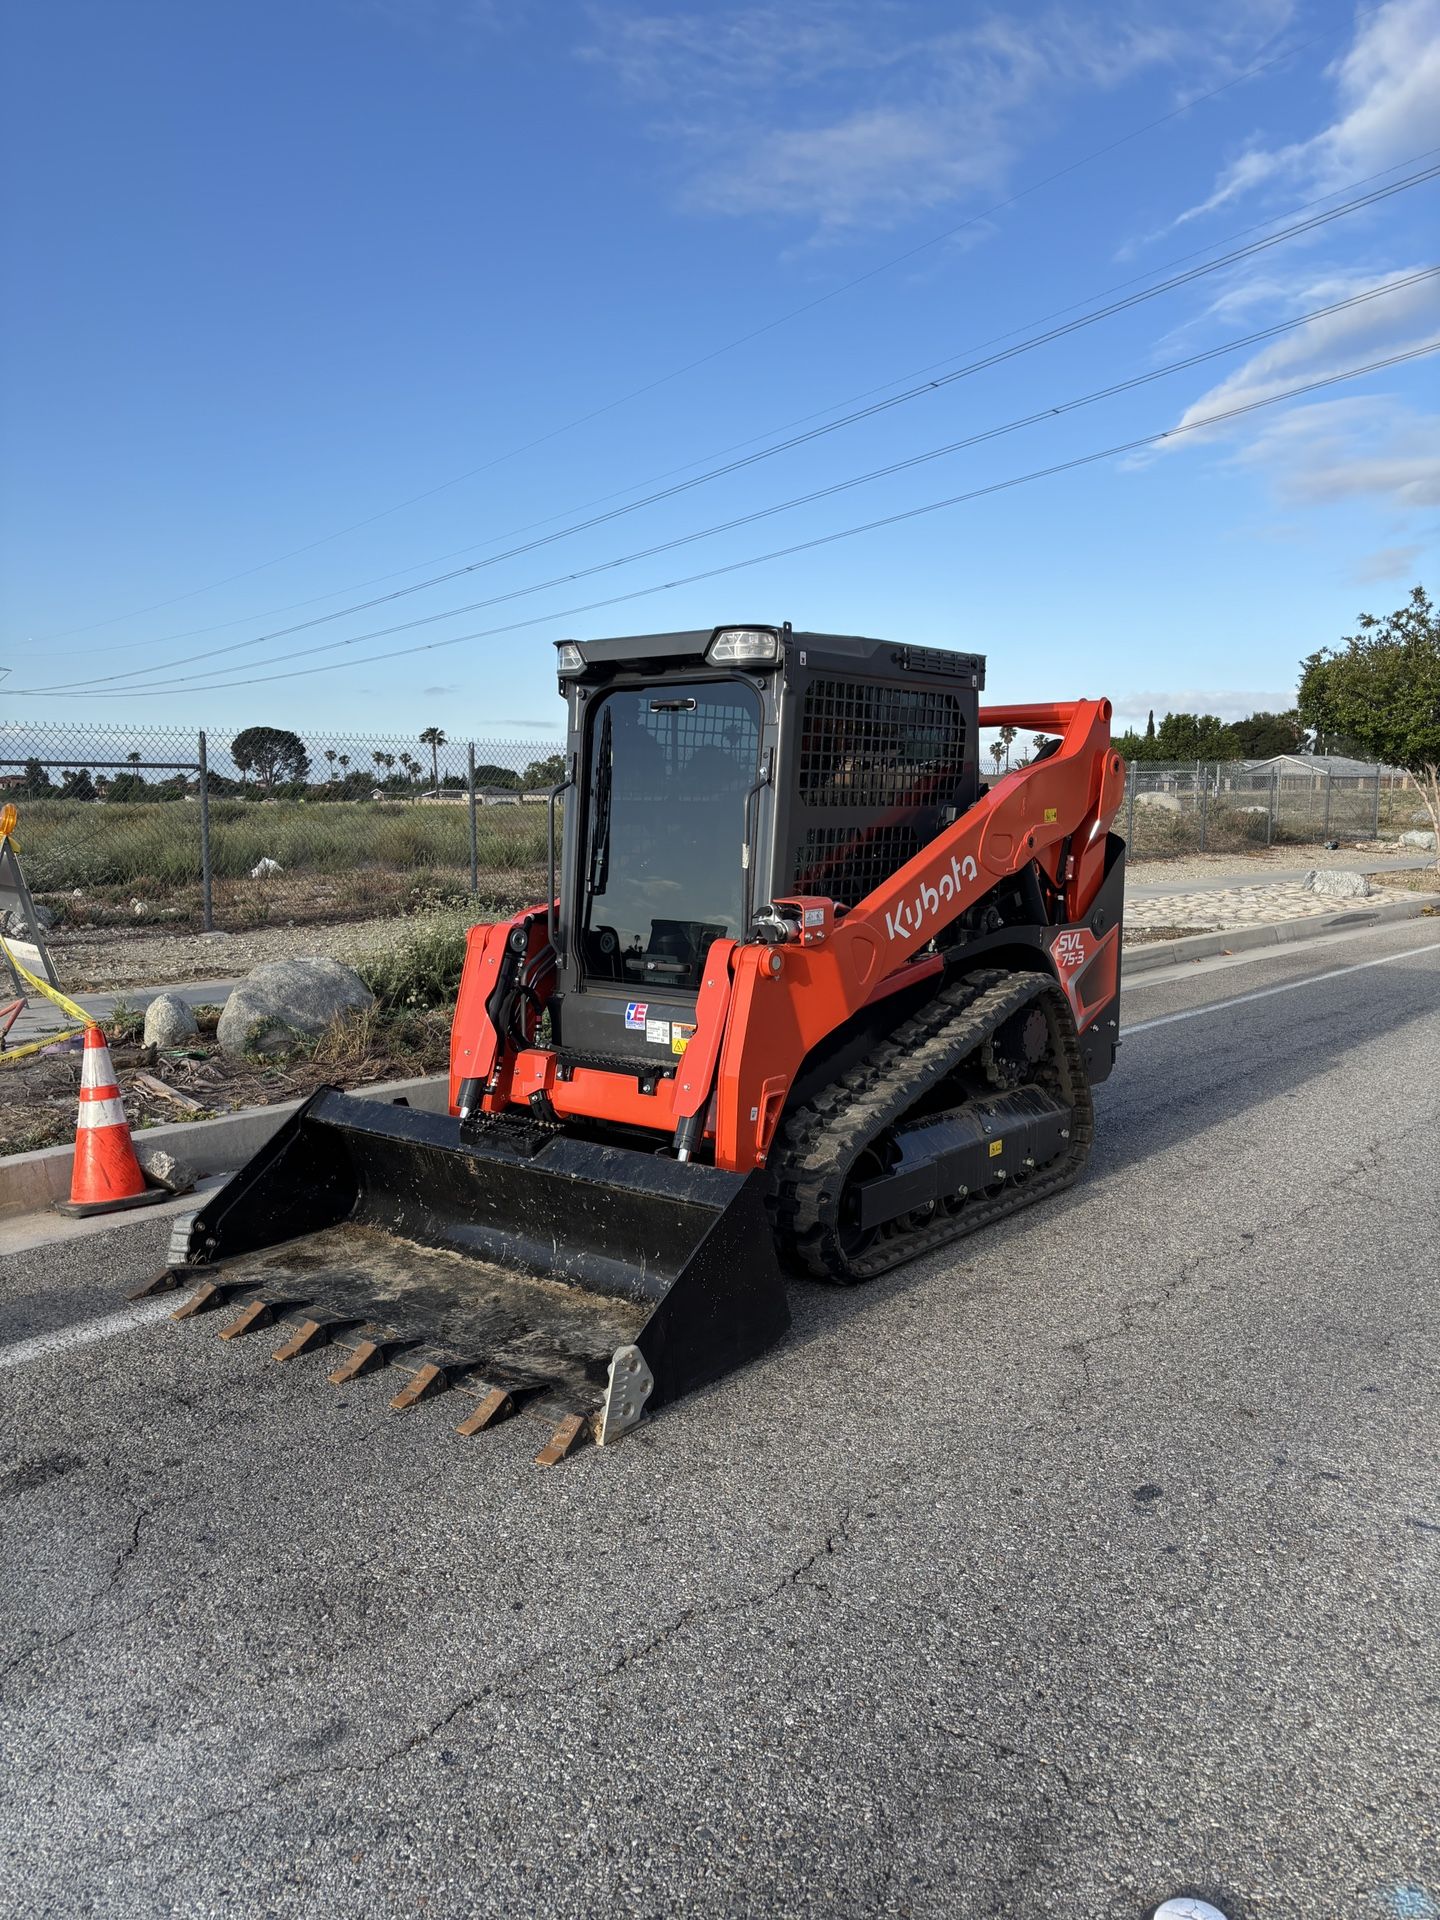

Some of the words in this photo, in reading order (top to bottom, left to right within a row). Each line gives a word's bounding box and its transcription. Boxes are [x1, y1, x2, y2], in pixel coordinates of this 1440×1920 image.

[885, 855, 978, 940] Kubota
[1057, 933, 1084, 953] SVL
[1062, 950, 1085, 967] 75-3
